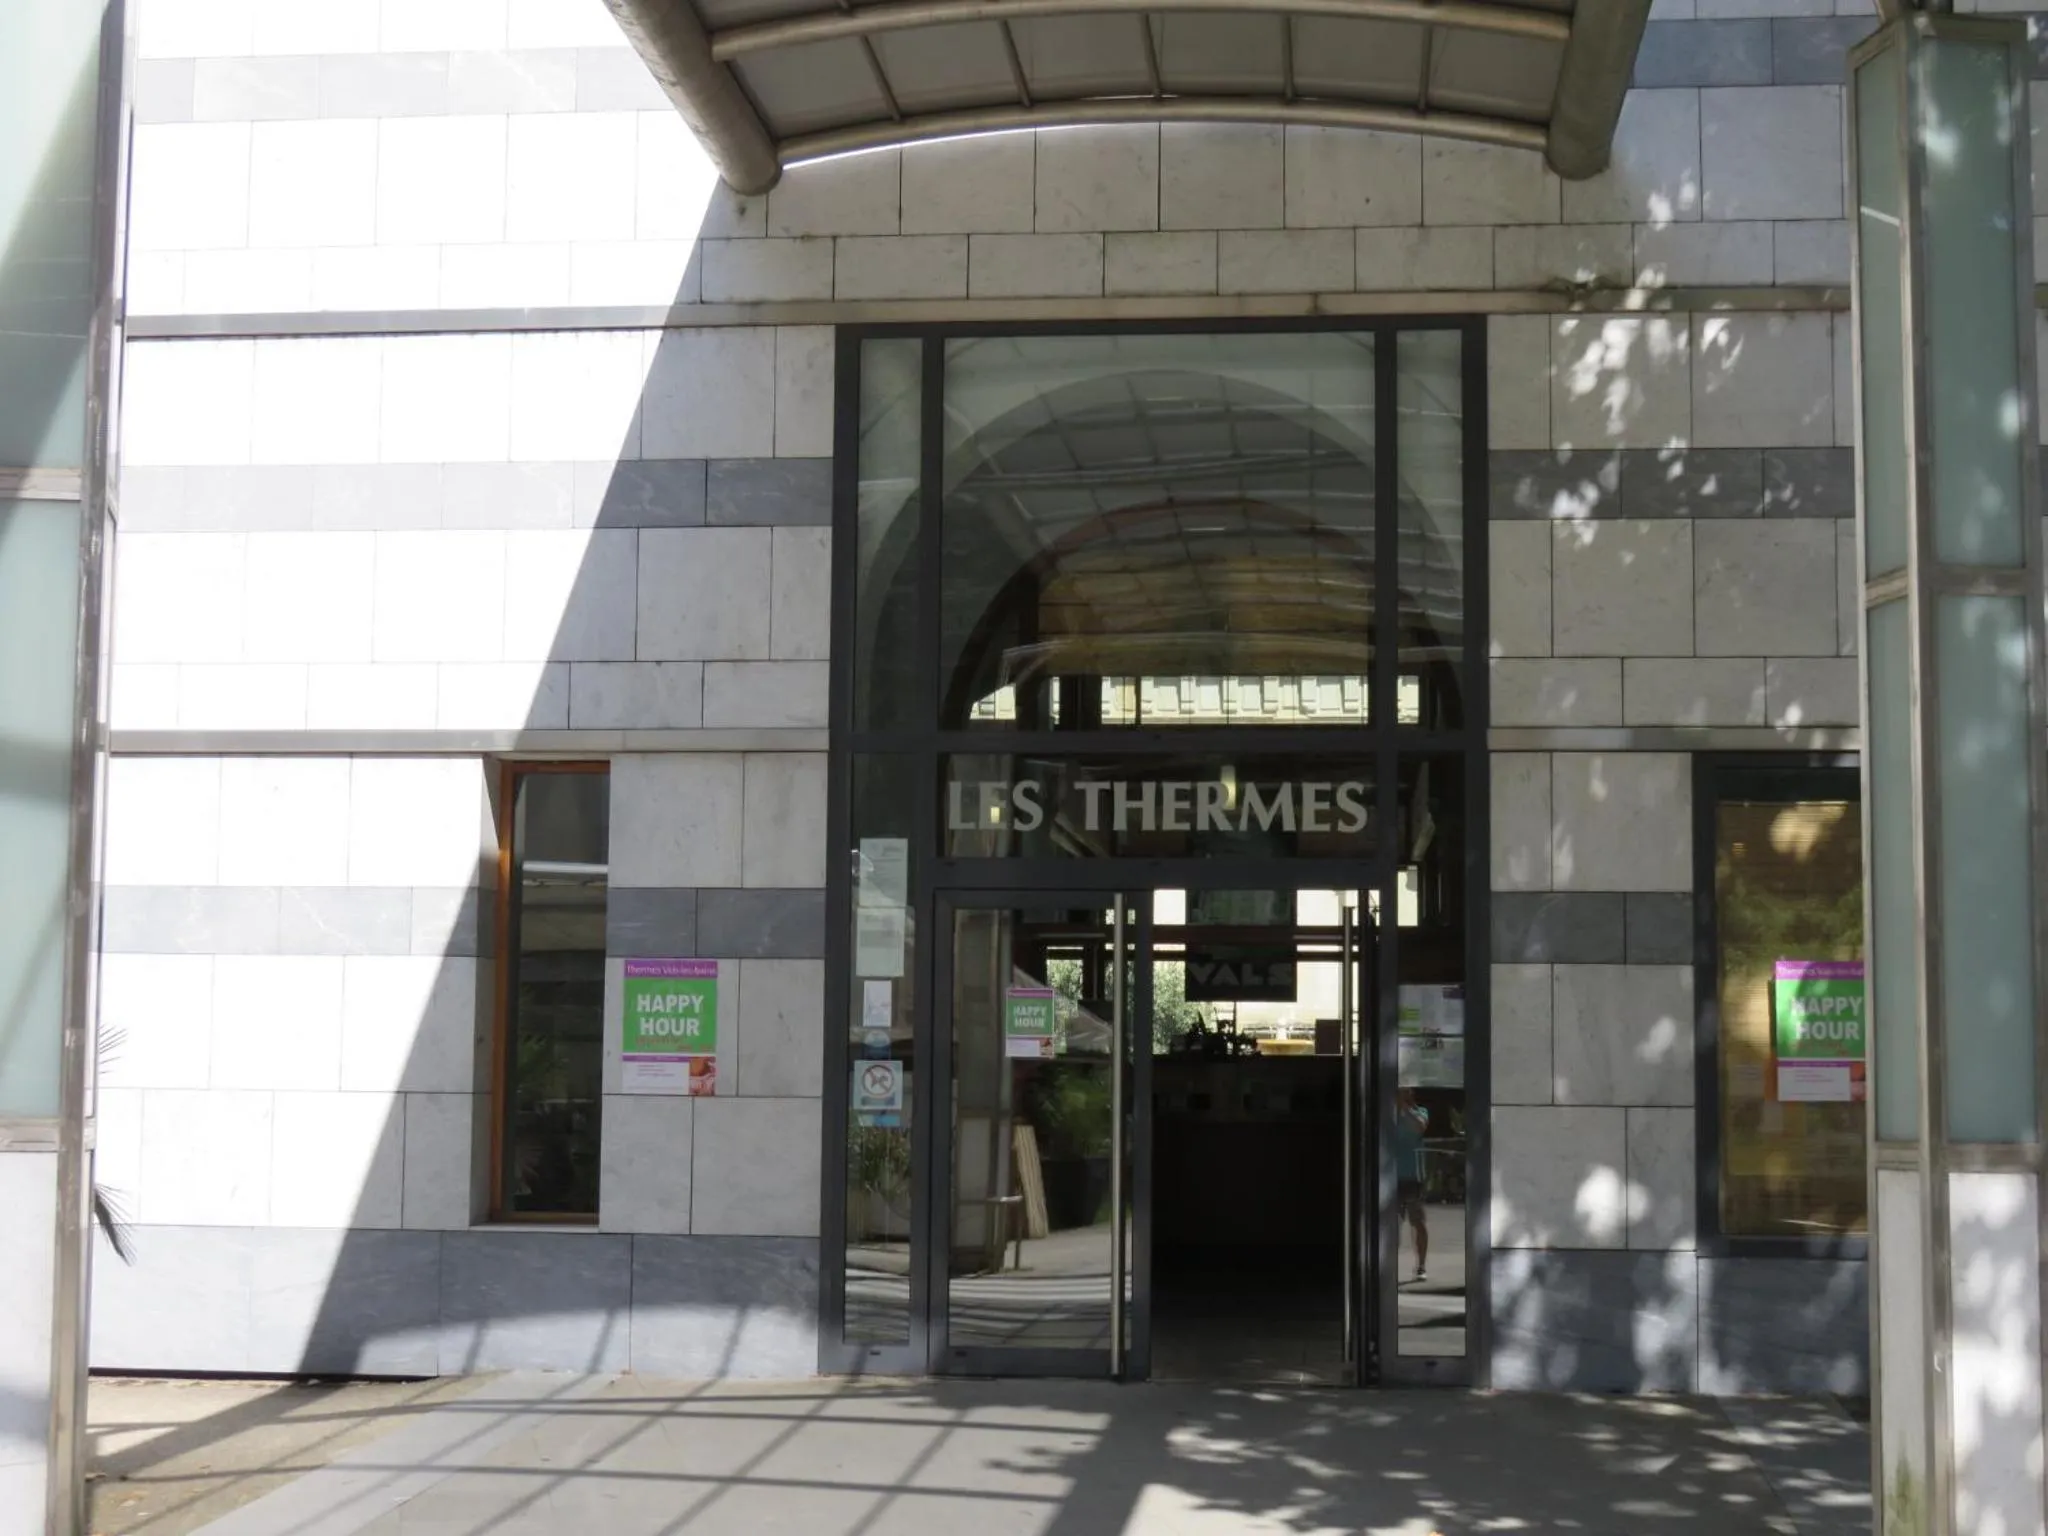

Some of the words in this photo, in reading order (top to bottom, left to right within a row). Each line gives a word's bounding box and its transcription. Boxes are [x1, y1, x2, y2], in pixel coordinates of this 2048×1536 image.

[948, 779, 1043, 832] LES
[1074, 780, 1367, 834] THERMES
[1187, 962, 1292, 986] VALS
[637, 993, 704, 1013] HAPPY
[1013, 1005, 1047, 1017] HAPPY
[1790, 995, 1863, 1016] HAPPY
[640, 1017, 700, 1036] HOUR
[1014, 1017, 1045, 1028] HOUR
[1794, 1020, 1859, 1039] HOUR
